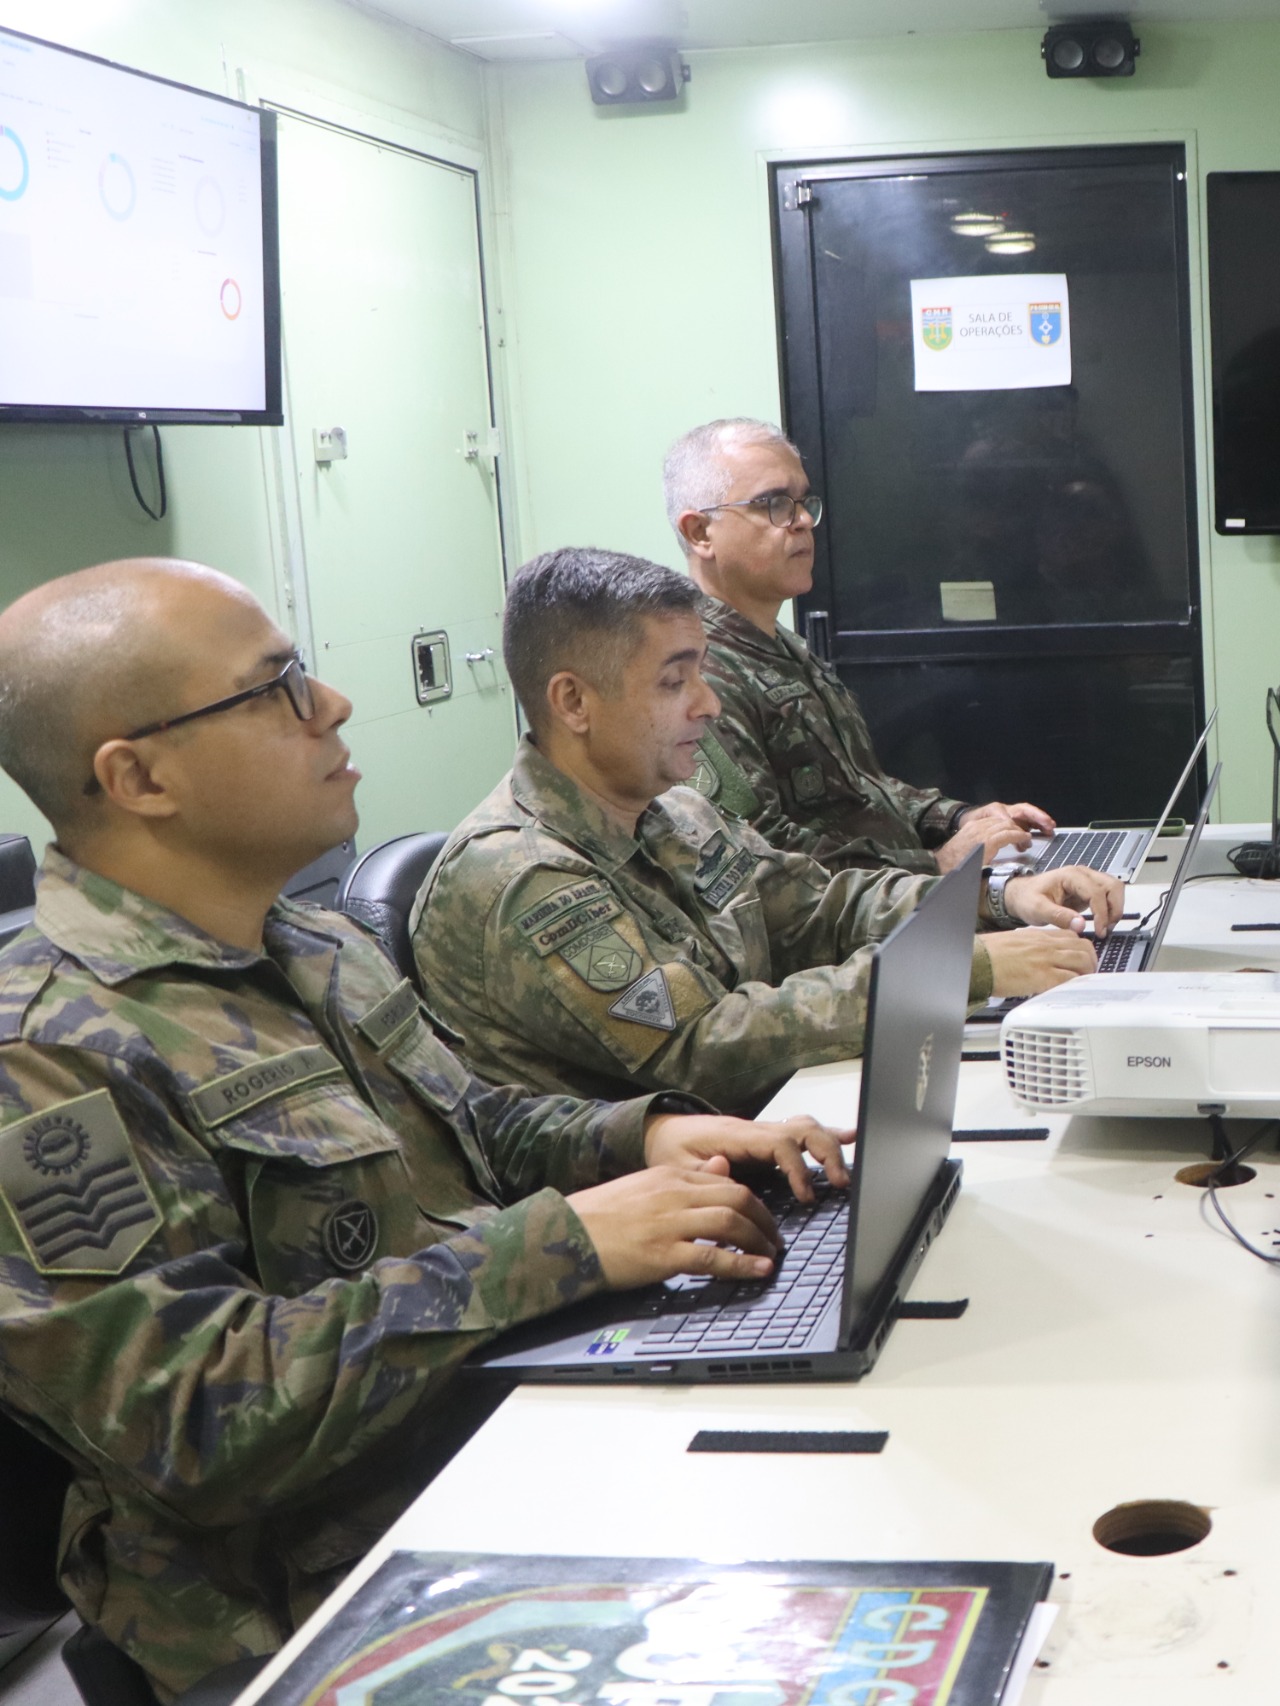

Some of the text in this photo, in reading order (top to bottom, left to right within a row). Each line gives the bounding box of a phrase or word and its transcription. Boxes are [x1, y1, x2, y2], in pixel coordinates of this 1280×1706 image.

[968, 312, 1013, 324] SALA DE
[959, 325, 1023, 338] OPERAÇÕES
[520, 902, 560, 930] MARINHA
[558, 894, 572, 906] DO
[1127, 1056, 1171, 1068] EPSON
